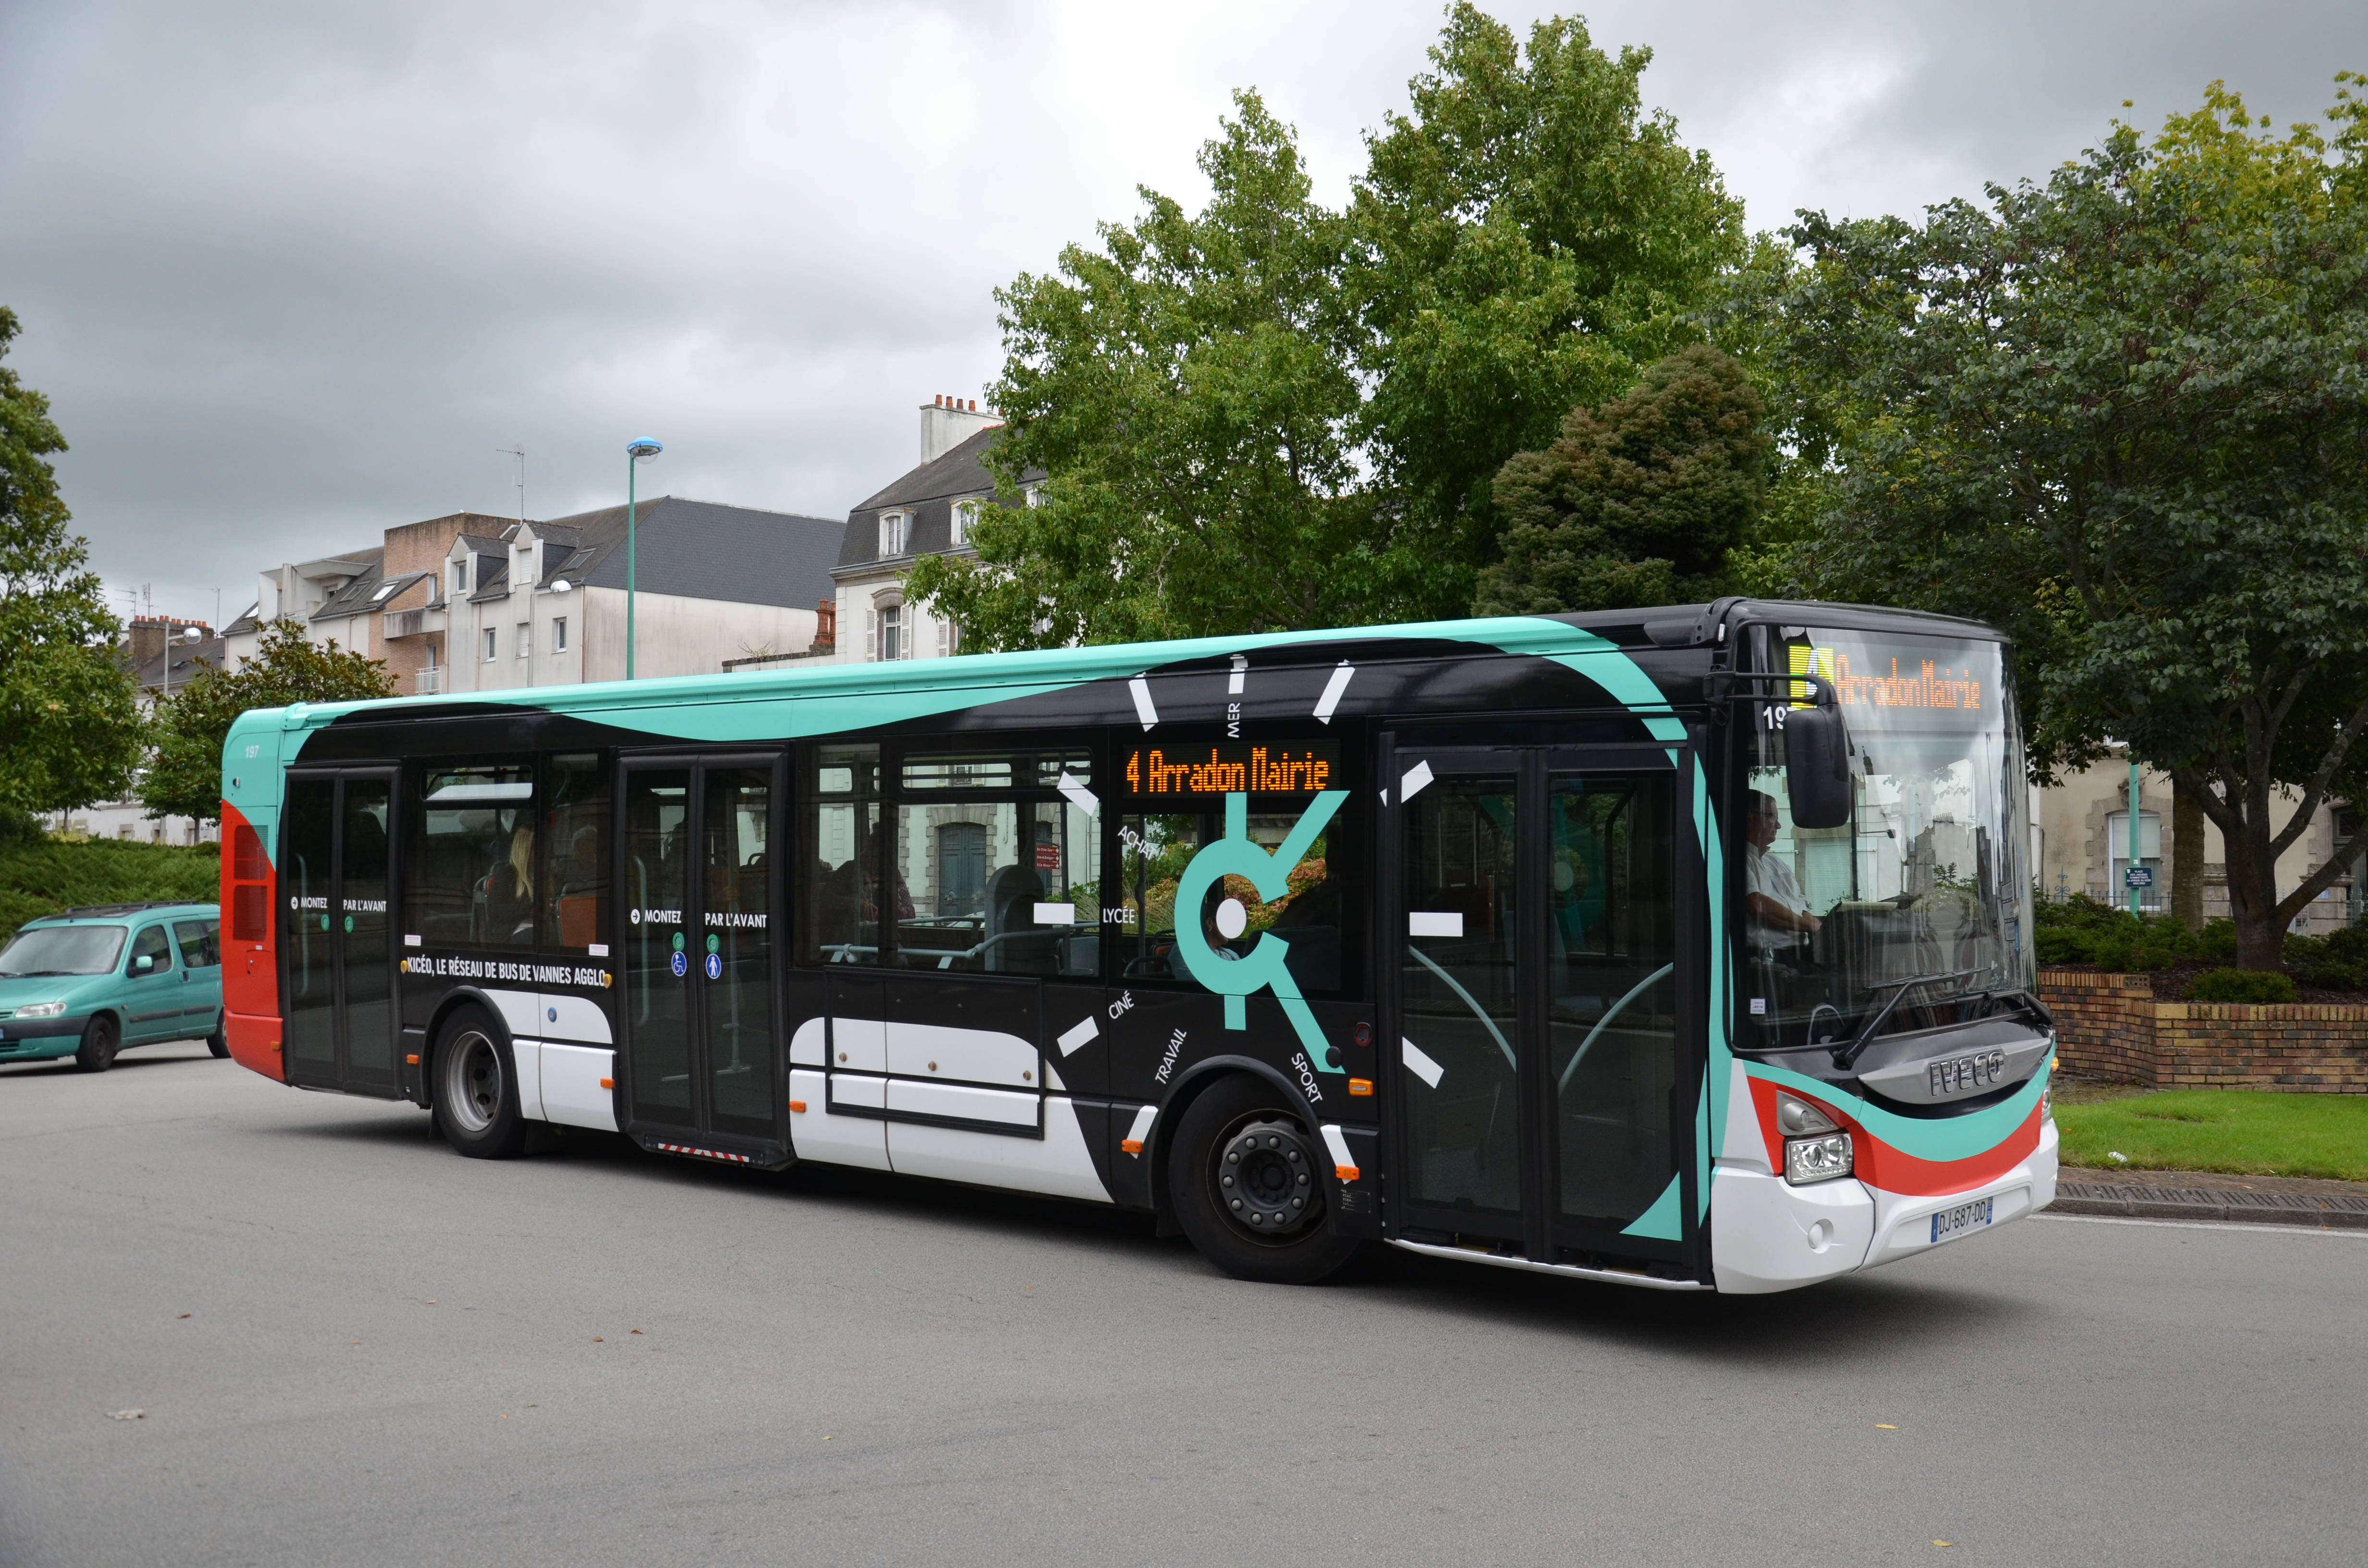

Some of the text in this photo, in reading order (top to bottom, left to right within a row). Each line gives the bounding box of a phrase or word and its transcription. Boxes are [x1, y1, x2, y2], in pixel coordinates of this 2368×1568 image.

[1836, 654, 1921, 706] Arradon
[1922, 660, 1980, 709] Mairie
[1227, 702, 1241, 738] MER
[246, 745, 259, 759] 197
[1127, 747, 1329, 792] 4 Arradon Mairie
[1118, 825, 1157, 860] ACHAT
[301, 897, 387, 912] MONTEZ PAR L'AVANT
[644, 909, 767, 928] MONTEZ PAR L'AVANT
[1103, 906, 1135, 924] LYCÉE
[407, 954, 606, 986] KICÉO, LE RÉSEAU DE BUS DE VANNES AGGLO
[1109, 990, 1135, 1019] CINÉ
[1155, 1028, 1187, 1085] TRAVAIL
[1930, 1051, 2005, 1096] IVECO
[1291, 1053, 1323, 1103] SPORT
